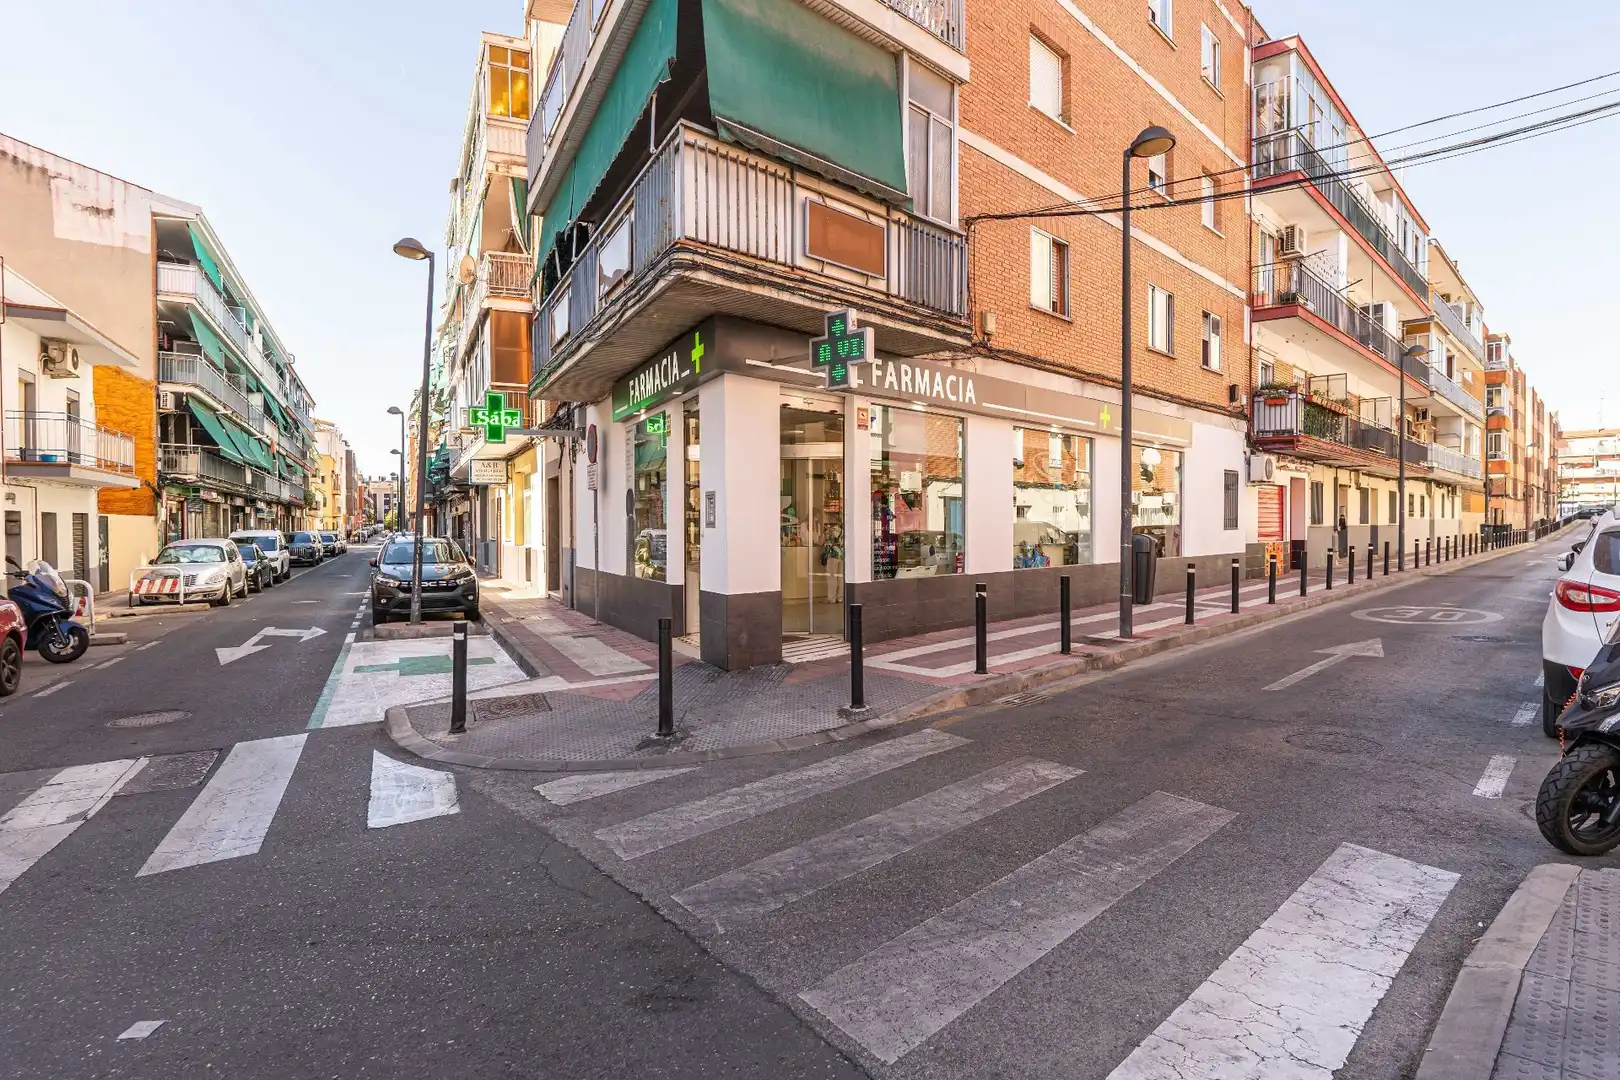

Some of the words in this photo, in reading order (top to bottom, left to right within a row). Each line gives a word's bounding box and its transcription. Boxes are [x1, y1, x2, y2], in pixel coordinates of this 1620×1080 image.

[629, 351, 679, 406] FARMACIA
[872, 359, 976, 404] FARMACIA
[1384, 609, 1466, 621] 30
